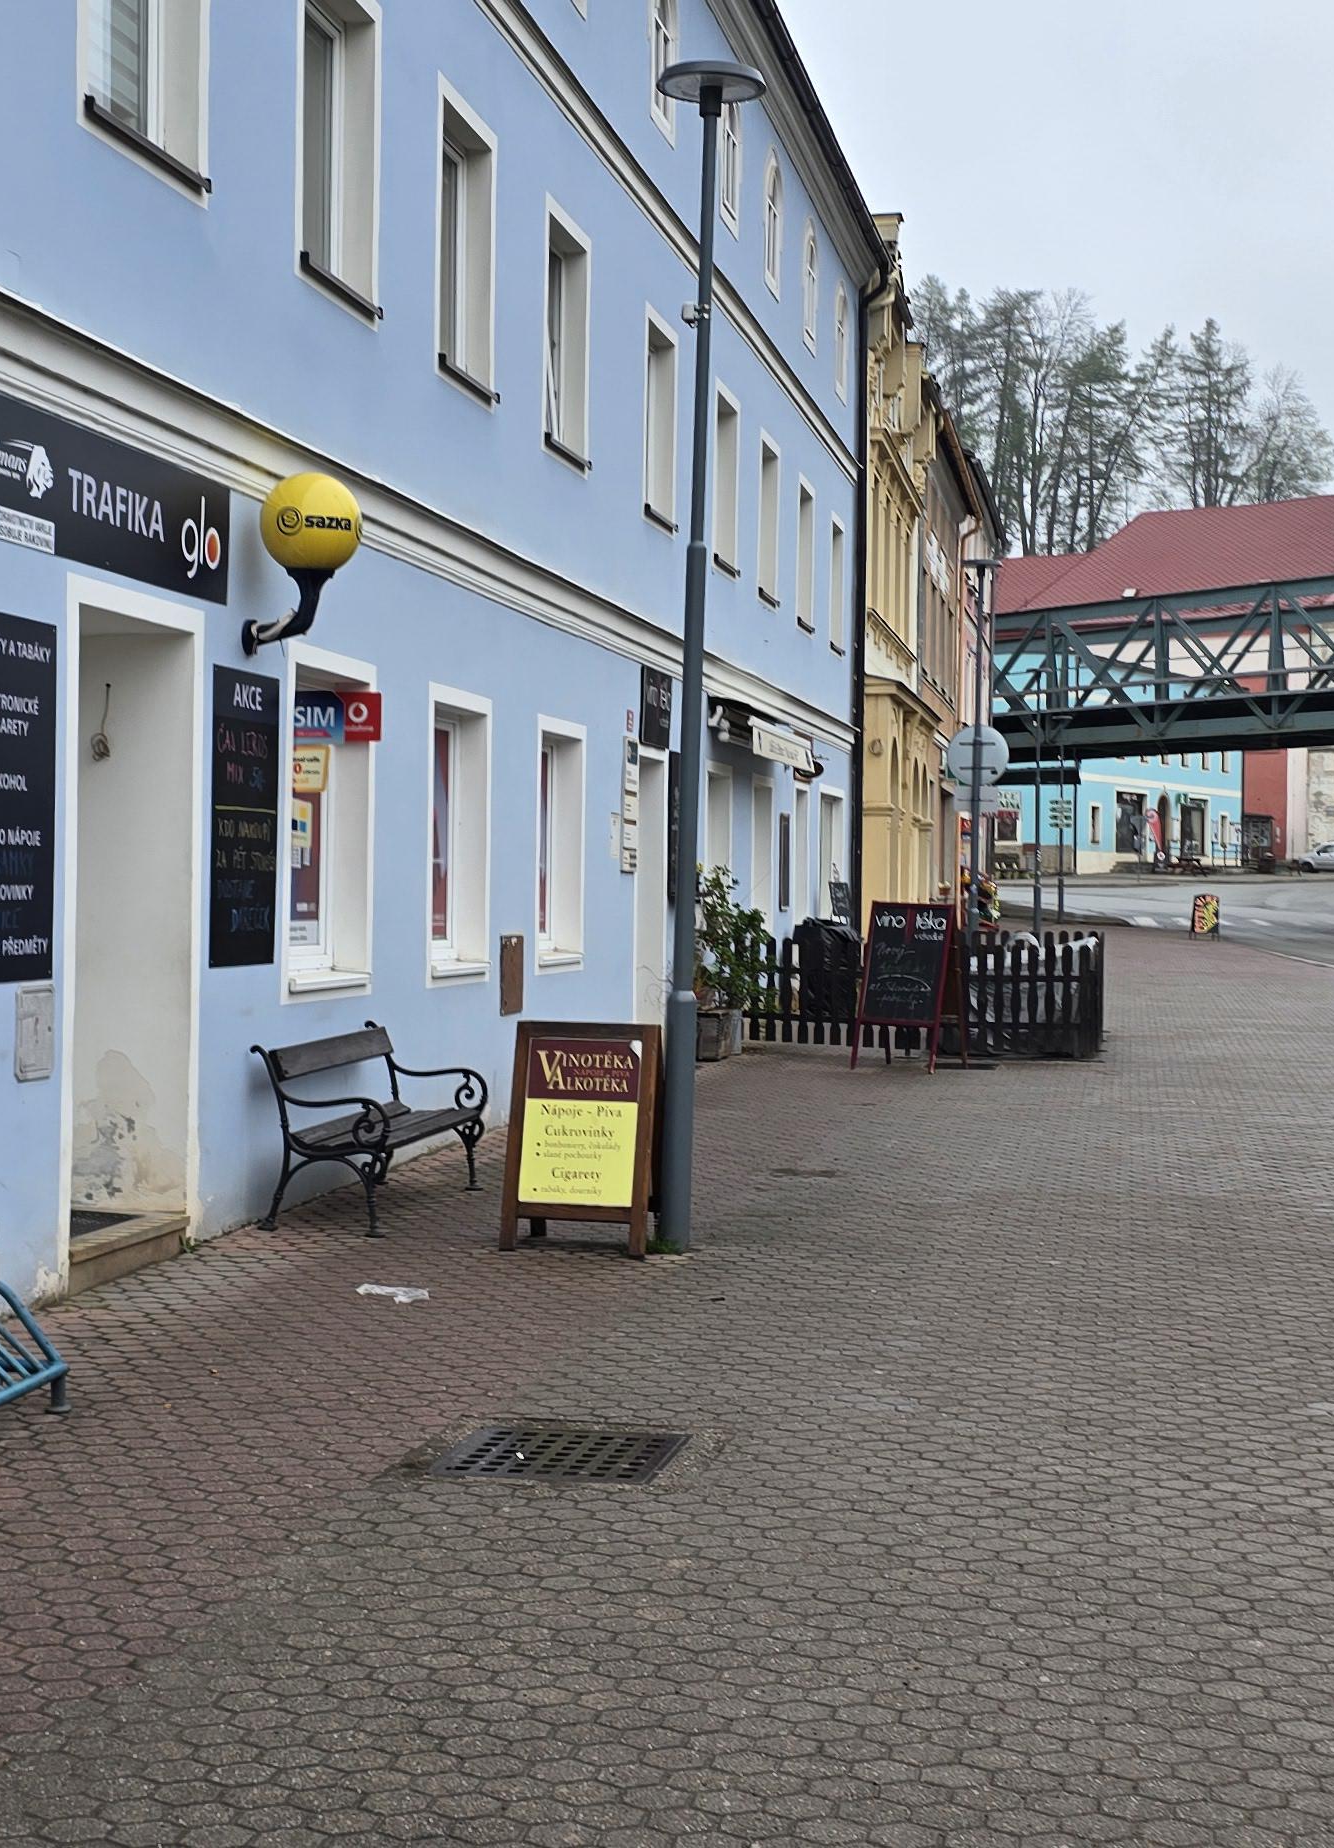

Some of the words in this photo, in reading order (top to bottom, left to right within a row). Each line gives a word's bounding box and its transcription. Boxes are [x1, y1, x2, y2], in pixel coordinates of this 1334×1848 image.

[67, 468, 165, 543] TRAFIKA
[181, 496, 221, 579] glo
[9, 643, 16, 657] A
[17, 642, 51, 664] TABÁKY
[233, 682, 263, 711] AKCE
[294, 705, 336, 728] SIM
[7, 826, 41, 846] NÁPOJE
[2, 934, 48, 956] PŘEDMĚTY
[537, 1050, 634, 1082] VINOTÉKA
[547, 1066, 629, 1093] ALKOTÉKA
[541, 1103, 583, 1119] Nápoje
[545, 1125, 616, 1140] Cukrovinky
[552, 1167, 602, 1182] Cigarety
